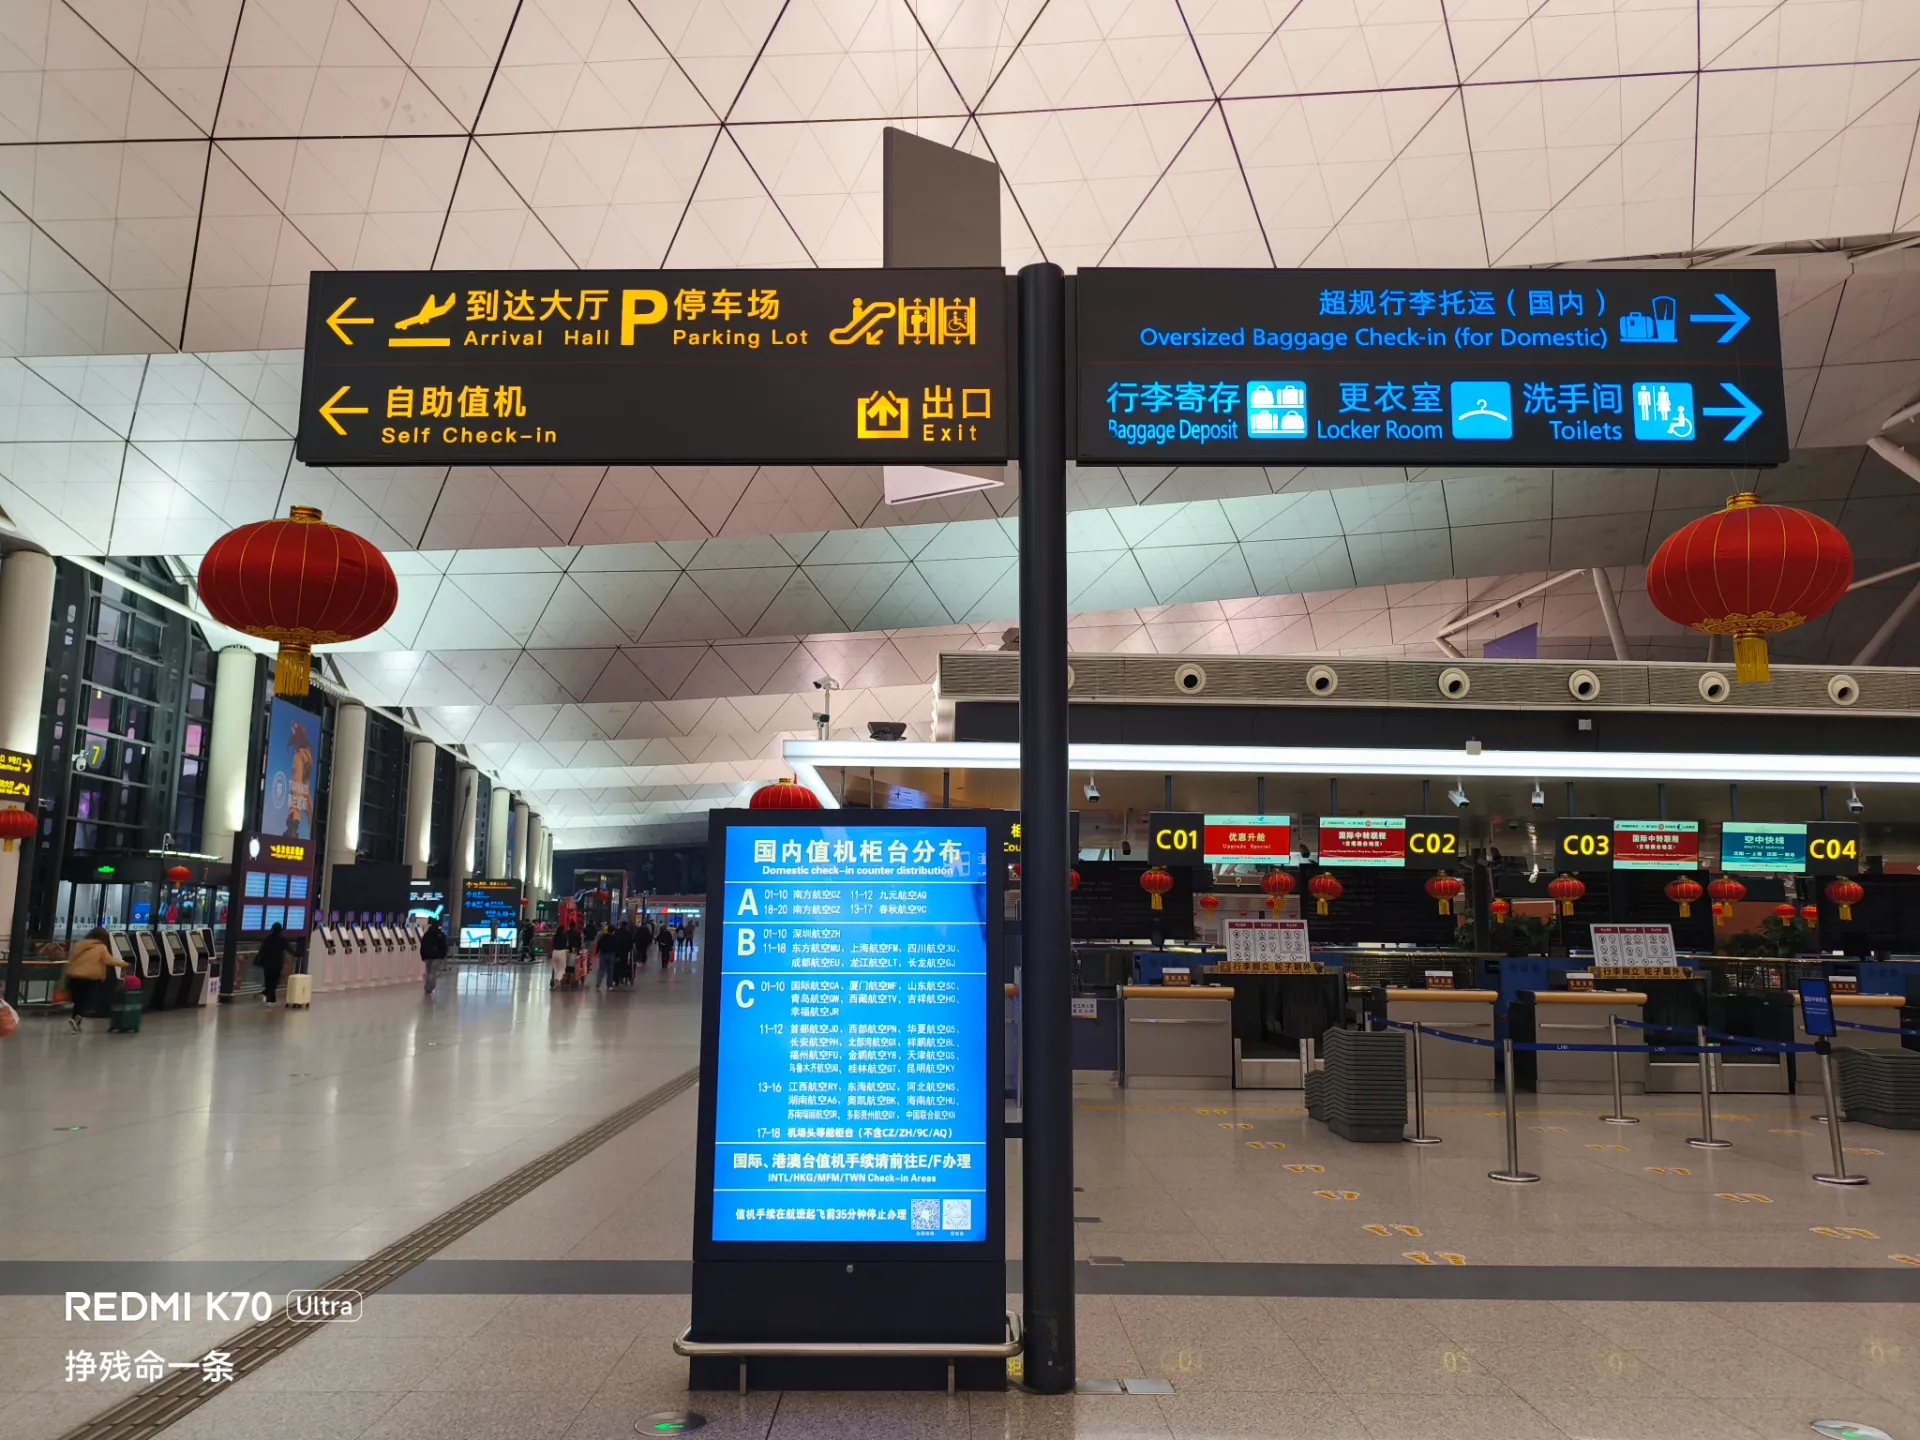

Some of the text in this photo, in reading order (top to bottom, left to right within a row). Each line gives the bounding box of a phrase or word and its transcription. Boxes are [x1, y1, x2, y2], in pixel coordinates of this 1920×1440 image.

[465, 288, 609, 322] 到达大厅
[673, 288, 781, 321] 停车场
[621, 289, 668, 346] P
[463, 328, 609, 346] Arrival Hall
[673, 328, 808, 350] Parking Lot
[1139, 327, 1607, 351] Oversized Baggage Check-in (for Domestic)
[386, 385, 526, 420] 自助值机
[922, 384, 991, 420] 出口
[1106, 381, 1241, 415] 行李寄存
[1339, 382, 1443, 414] 更衣室
[1522, 382, 1622, 414] 洗手间
[382, 427, 557, 445] Self Check-in
[924, 423, 978, 441] Exit
[1107, 419, 1239, 444] Baggage Deposit
[1317, 419, 1442, 440] Locker Room
[1550, 419, 1622, 440] Toilets
[92, 745, 101, 765] 7
[1156, 829, 1197, 850] C01
[1229, 832, 1266, 842] 优惠升舱
[1409, 833, 1455, 854] C02
[1563, 834, 1610, 856] C03
[1744, 835, 1785, 845] 空中快线
[754, 839, 963, 864] 国内值机柜台分布
[1809, 839, 1857, 860] C04
[762, 865, 954, 876] Domestic check-in counter distribution
[737, 888, 759, 916] A
[764, 890, 788, 900] 01-10
[793, 889, 841, 900] 南方航空CZ
[850, 890, 873, 900] 11-12
[763, 904, 927, 915] 18-20 南方航空CZ 13-17 春秋航空9C
[737, 928, 756, 956] B
[763, 928, 841, 939] 01-10 深圳航空ZH
[763, 943, 786, 953] 11-18
[735, 980, 755, 1008] C
[761, 981, 785, 991] 01-10
[759, 1024, 783, 1034] 11-12
[758, 1082, 782, 1093] 13-16
[756, 1128, 780, 1139] 17-18
[733, 1153, 972, 1169] 国际、港澳台值机手续请前往E/F办理
[768, 1173, 937, 1183] INTL/HKG/MFM/TWN Check-in Areas
[736, 1208, 907, 1221] 值机手续在航班起飞前35分钟停止办理
